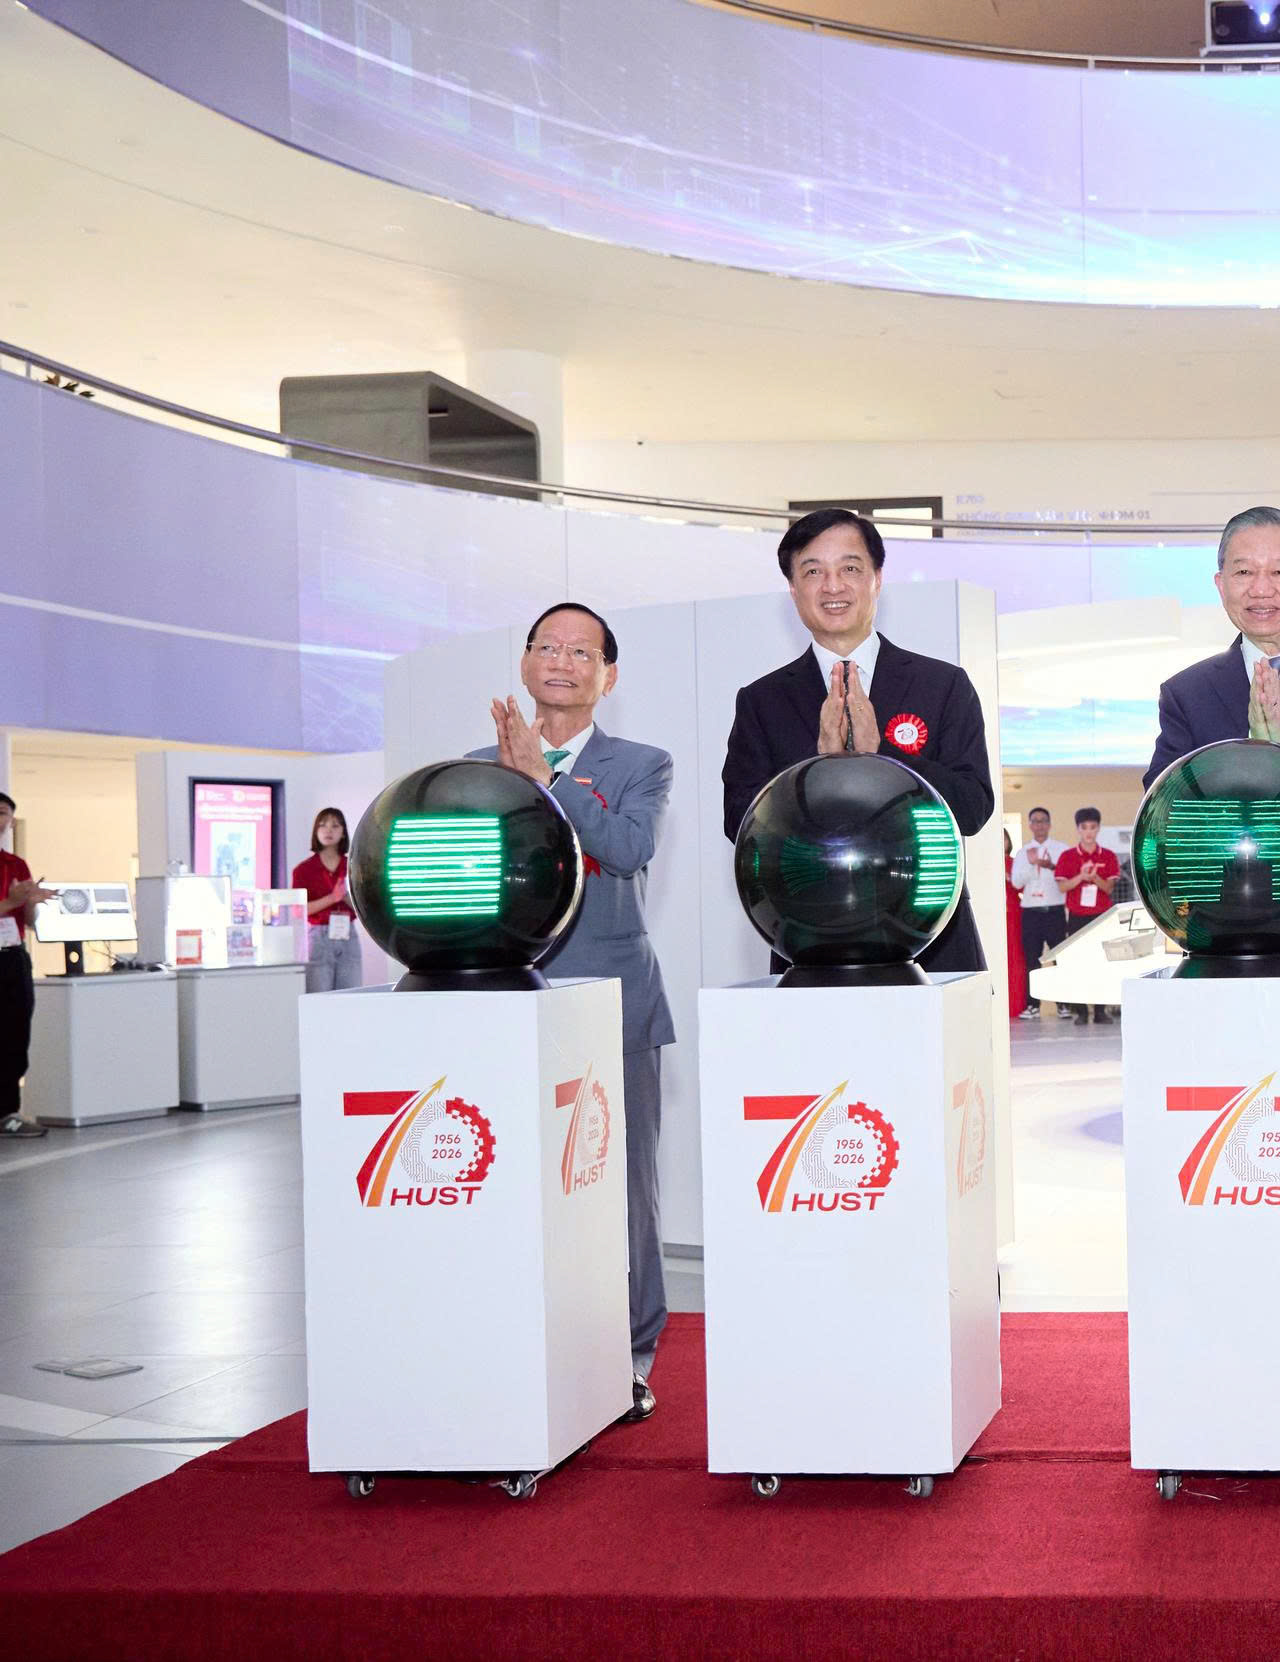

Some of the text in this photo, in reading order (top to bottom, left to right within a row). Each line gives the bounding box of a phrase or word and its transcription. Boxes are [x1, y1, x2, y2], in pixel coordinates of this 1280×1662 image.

[433, 1134, 461, 1144] 1956
[836, 1139, 863, 1149] 1956
[431, 1149, 462, 1159] 2026
[833, 1154, 864, 1164] 2026
[573, 1161, 606, 1191] HUST
[390, 1186, 482, 1206] HUST
[791, 1192, 884, 1212] HUST
